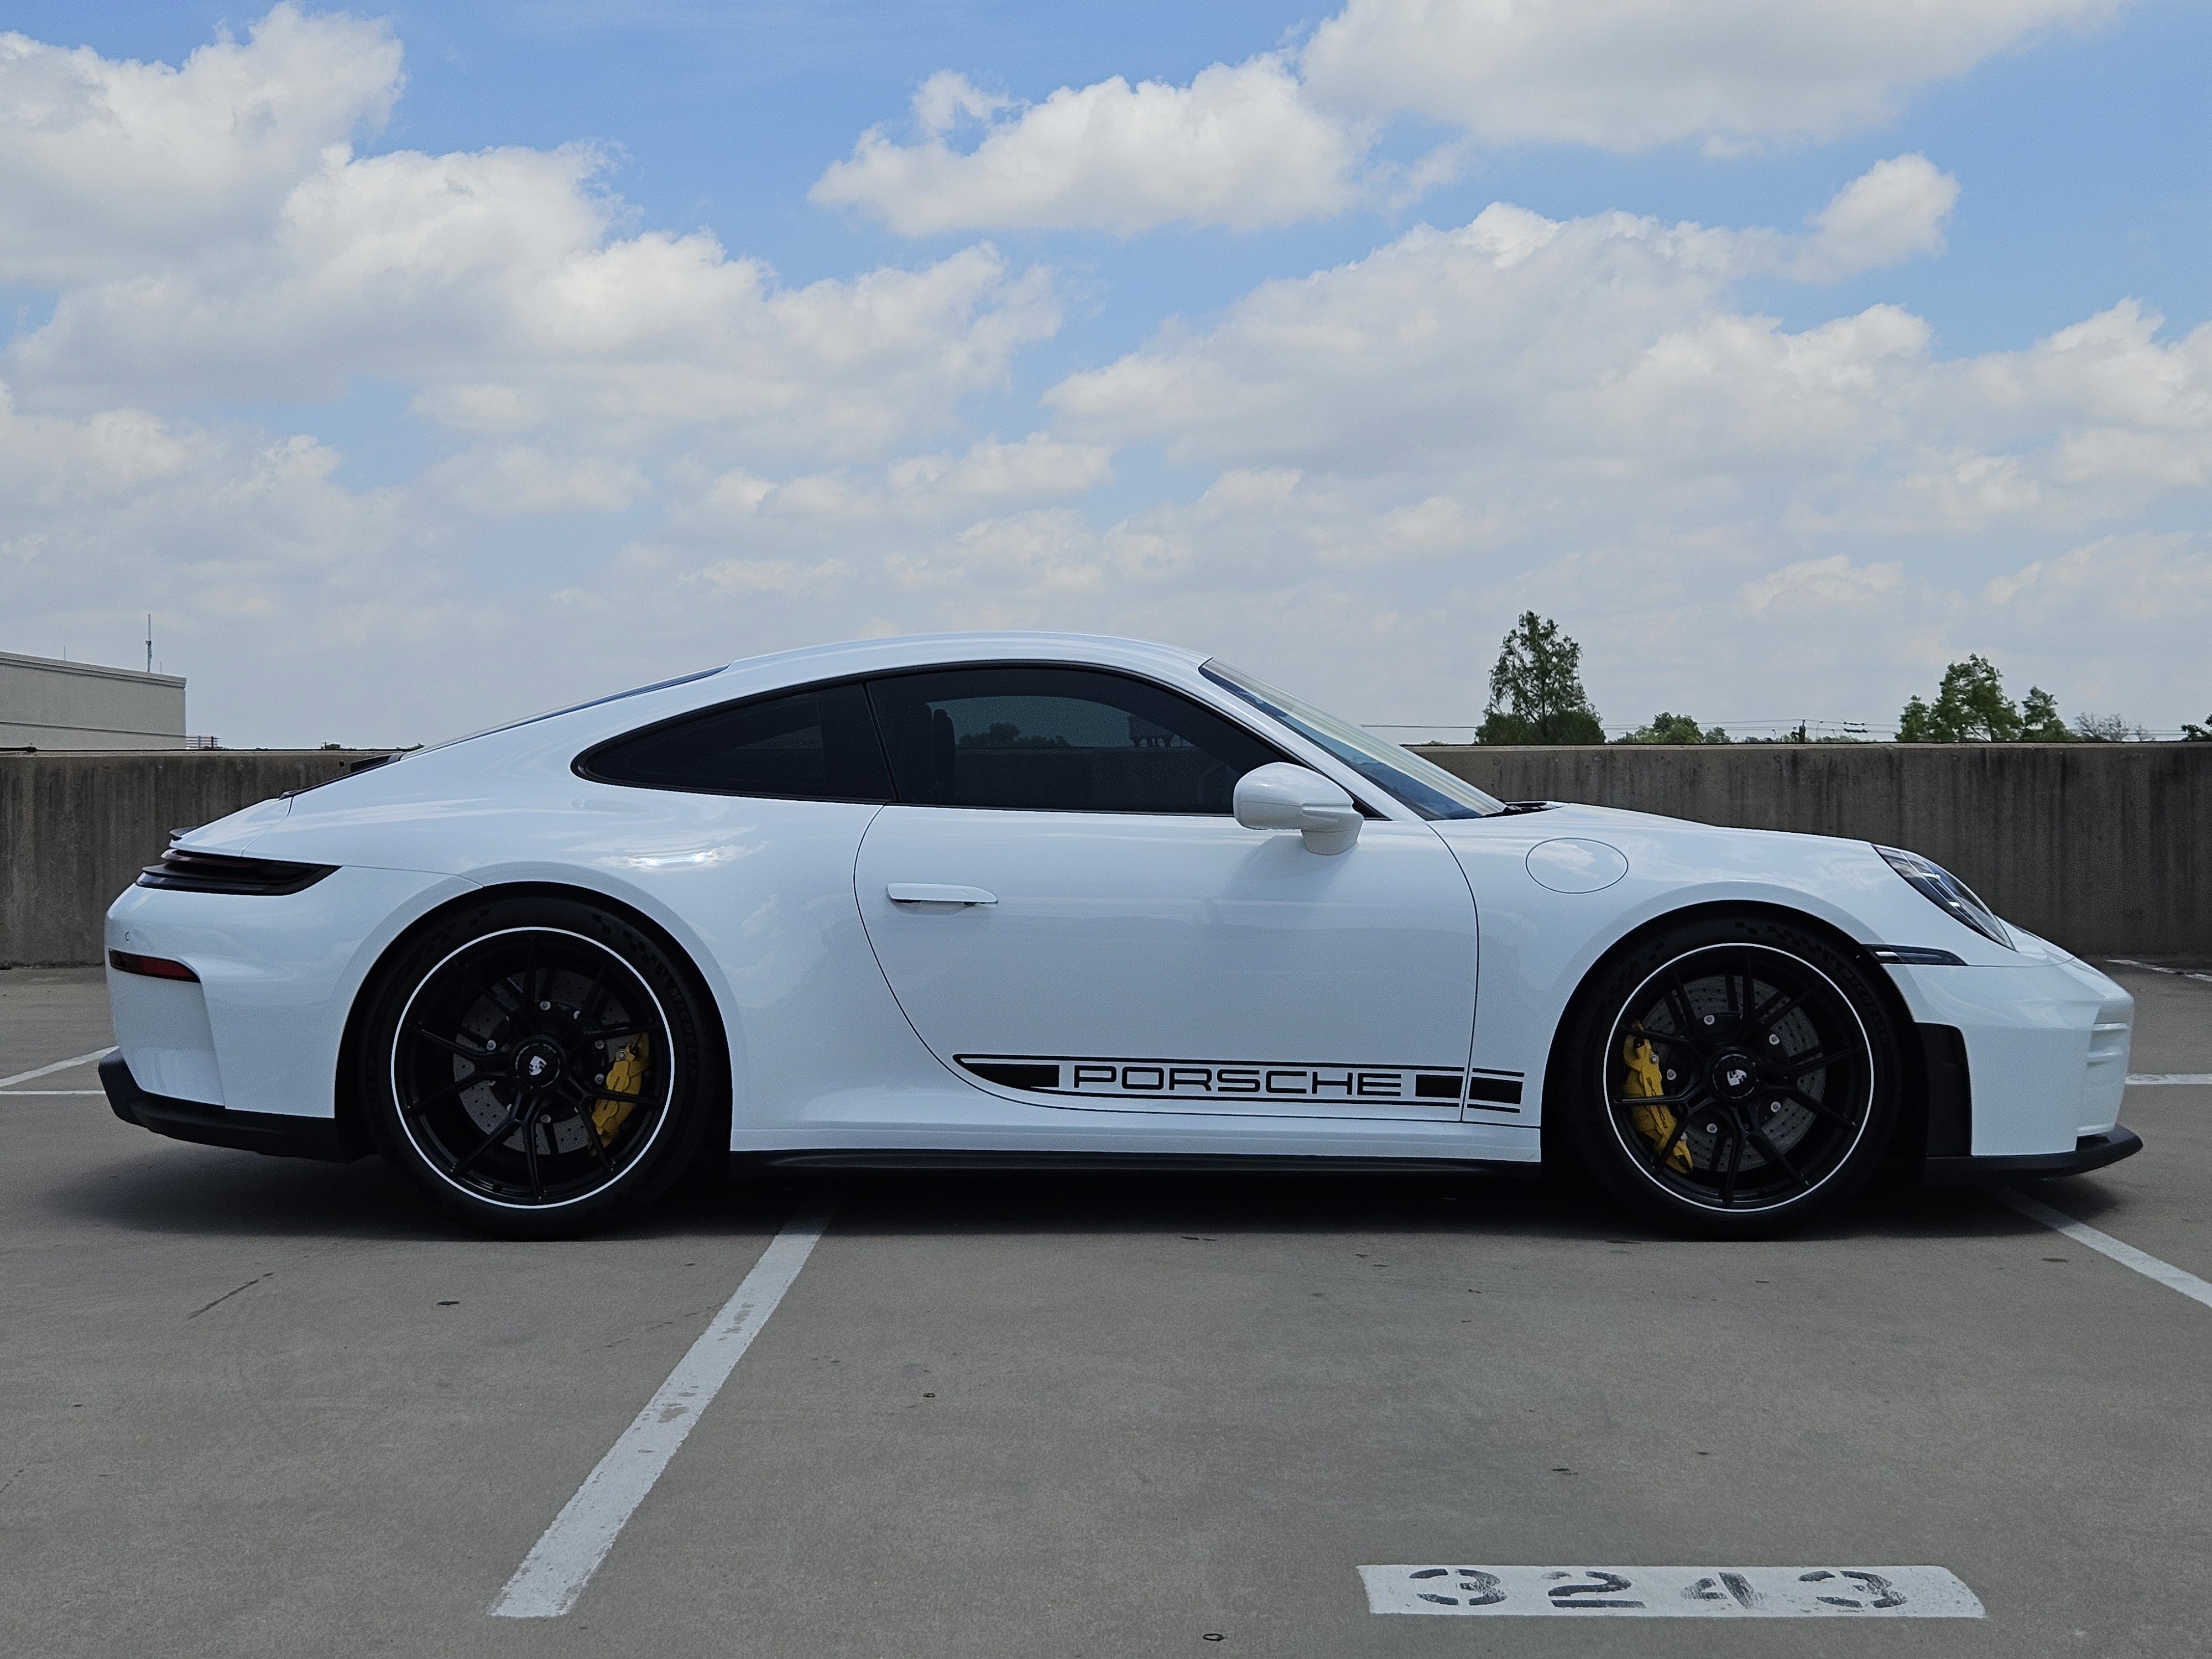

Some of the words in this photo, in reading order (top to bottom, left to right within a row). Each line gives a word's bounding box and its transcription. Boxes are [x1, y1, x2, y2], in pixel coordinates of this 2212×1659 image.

[667, 984, 698, 1078] MICHELIN
[1073, 1065, 1402, 1096] PORSCHE
[1646, 1077, 1667, 1128] PORCHE
[1408, 1568, 1908, 1609] 3243
